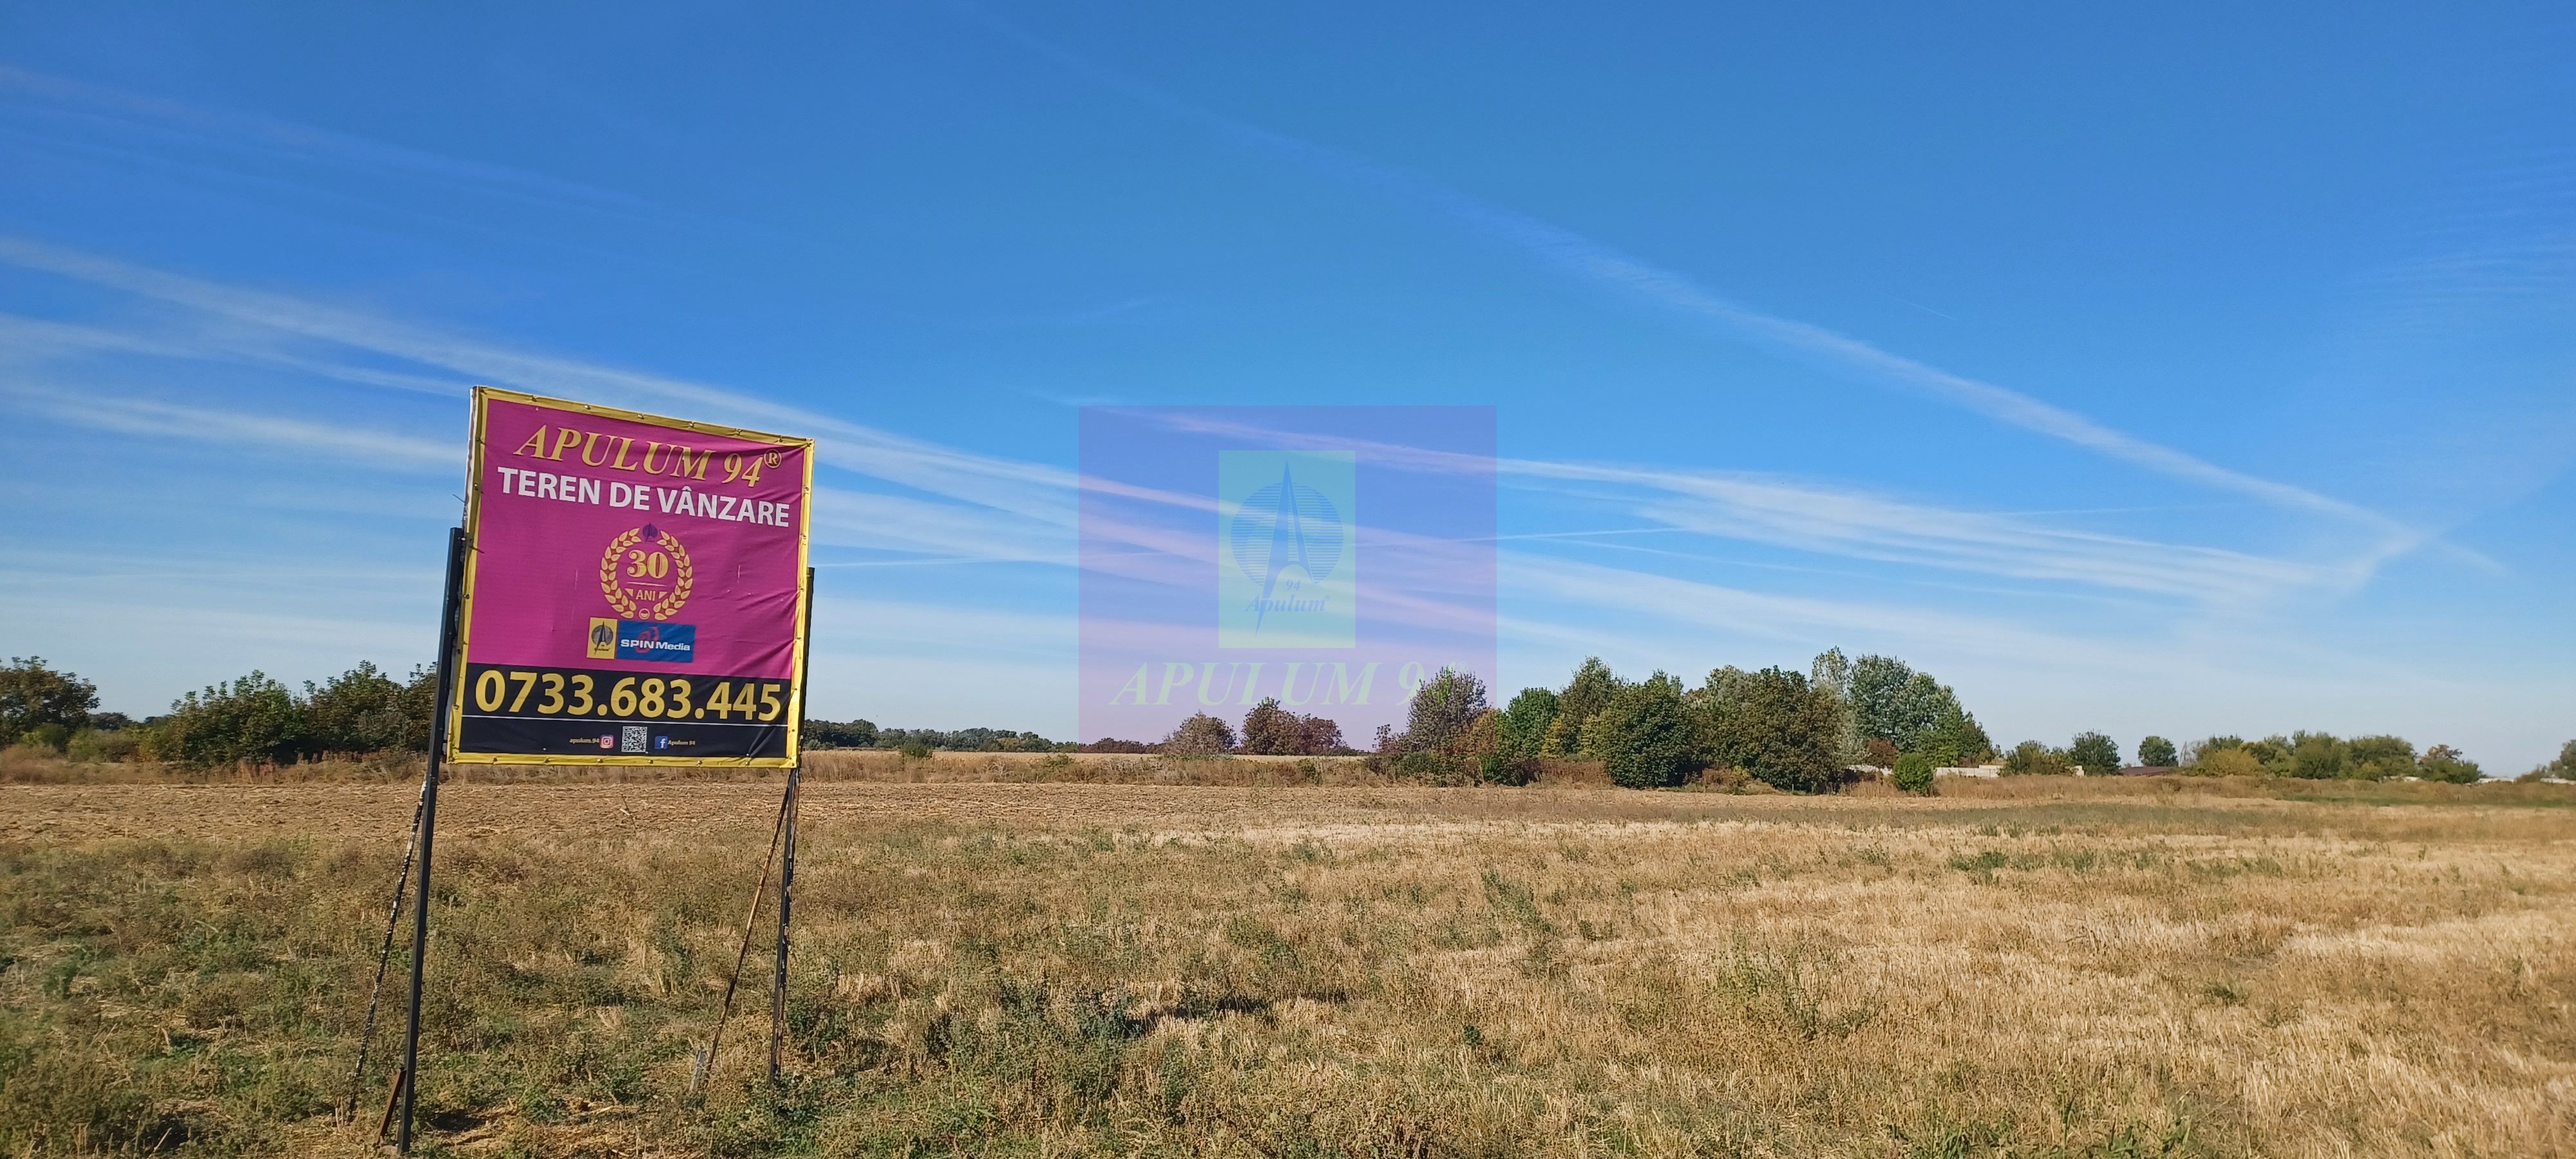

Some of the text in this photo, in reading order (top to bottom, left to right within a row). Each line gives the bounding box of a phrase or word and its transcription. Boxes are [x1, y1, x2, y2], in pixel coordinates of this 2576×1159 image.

[513, 424, 715, 480] APULUM
[497, 467, 790, 527] TEREN DE VÂNZARE
[627, 549, 669, 579] 30
[635, 589, 656, 601] ANI
[620, 639, 654, 649] SPIN
[656, 641, 690, 651] Media
[475, 670, 781, 721] 0733.683.445
